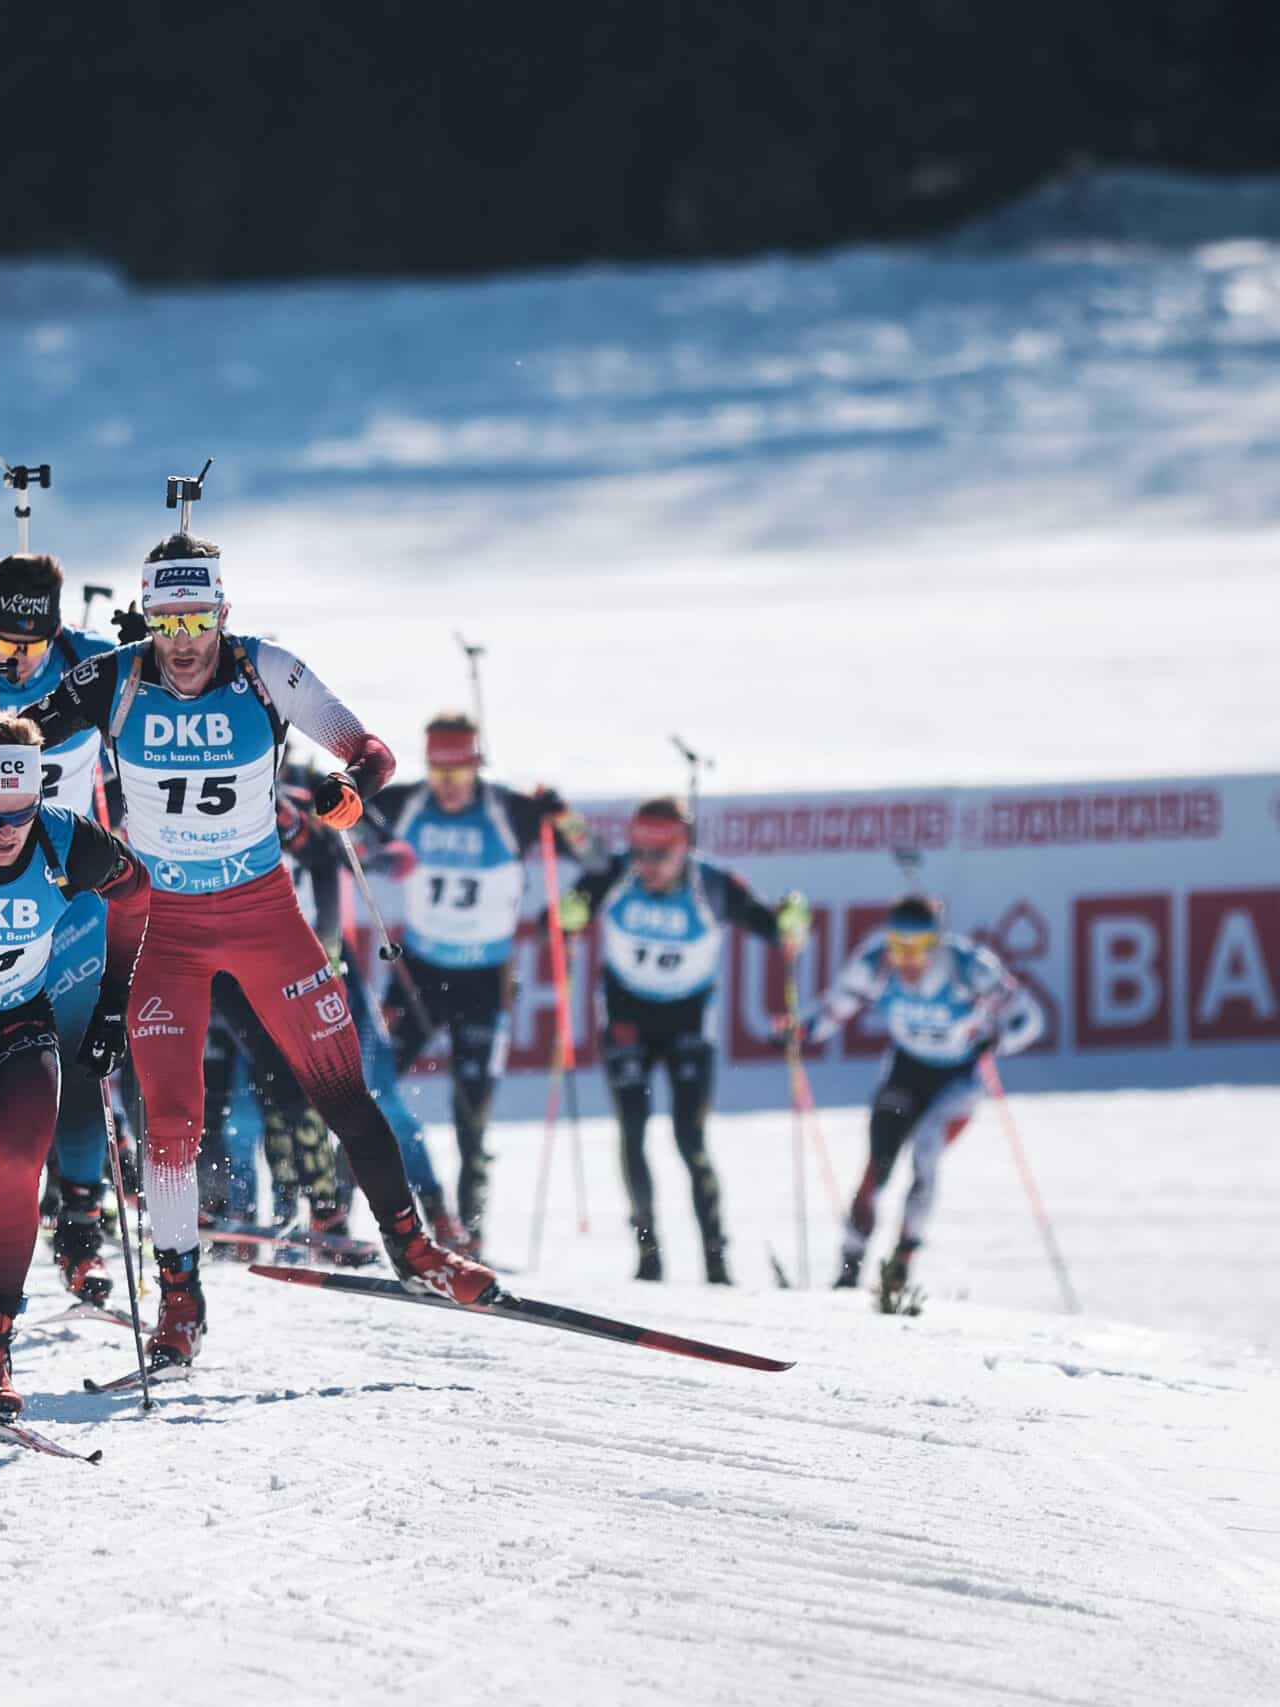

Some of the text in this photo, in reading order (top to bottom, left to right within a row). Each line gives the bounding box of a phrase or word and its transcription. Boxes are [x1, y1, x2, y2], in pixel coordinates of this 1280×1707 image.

[160, 568, 207, 580] pure
[144, 713, 233, 747] DKB
[143, 750, 234, 762] Das kann Bank
[158, 775, 238, 815] 15
[192, 852, 254, 889] THE iX
[428, 876, 479, 908] 13
[6, 931, 37, 942] Bank
